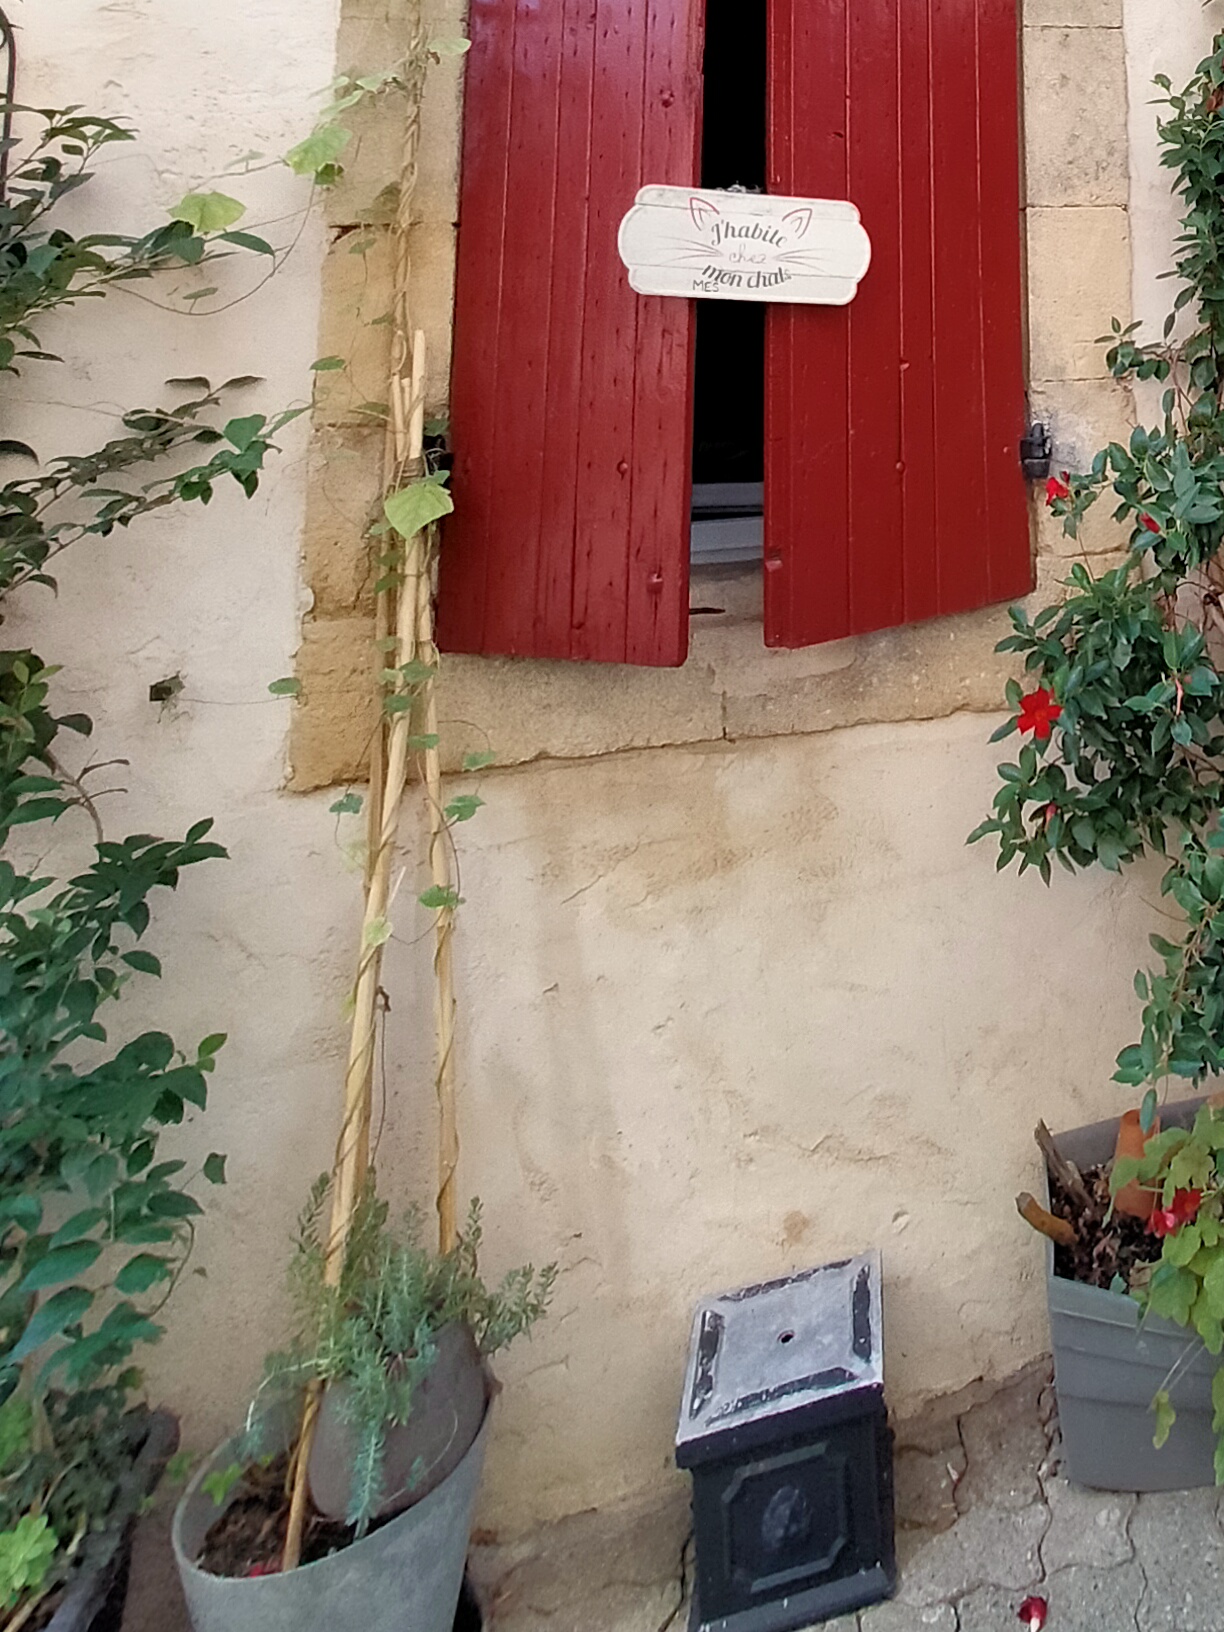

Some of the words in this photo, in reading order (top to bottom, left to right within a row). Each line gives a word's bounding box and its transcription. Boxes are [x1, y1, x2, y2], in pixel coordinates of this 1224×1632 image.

[728, 244, 767, 264] chez
[692, 279, 720, 293] MES
[701, 265, 743, 287] mon
